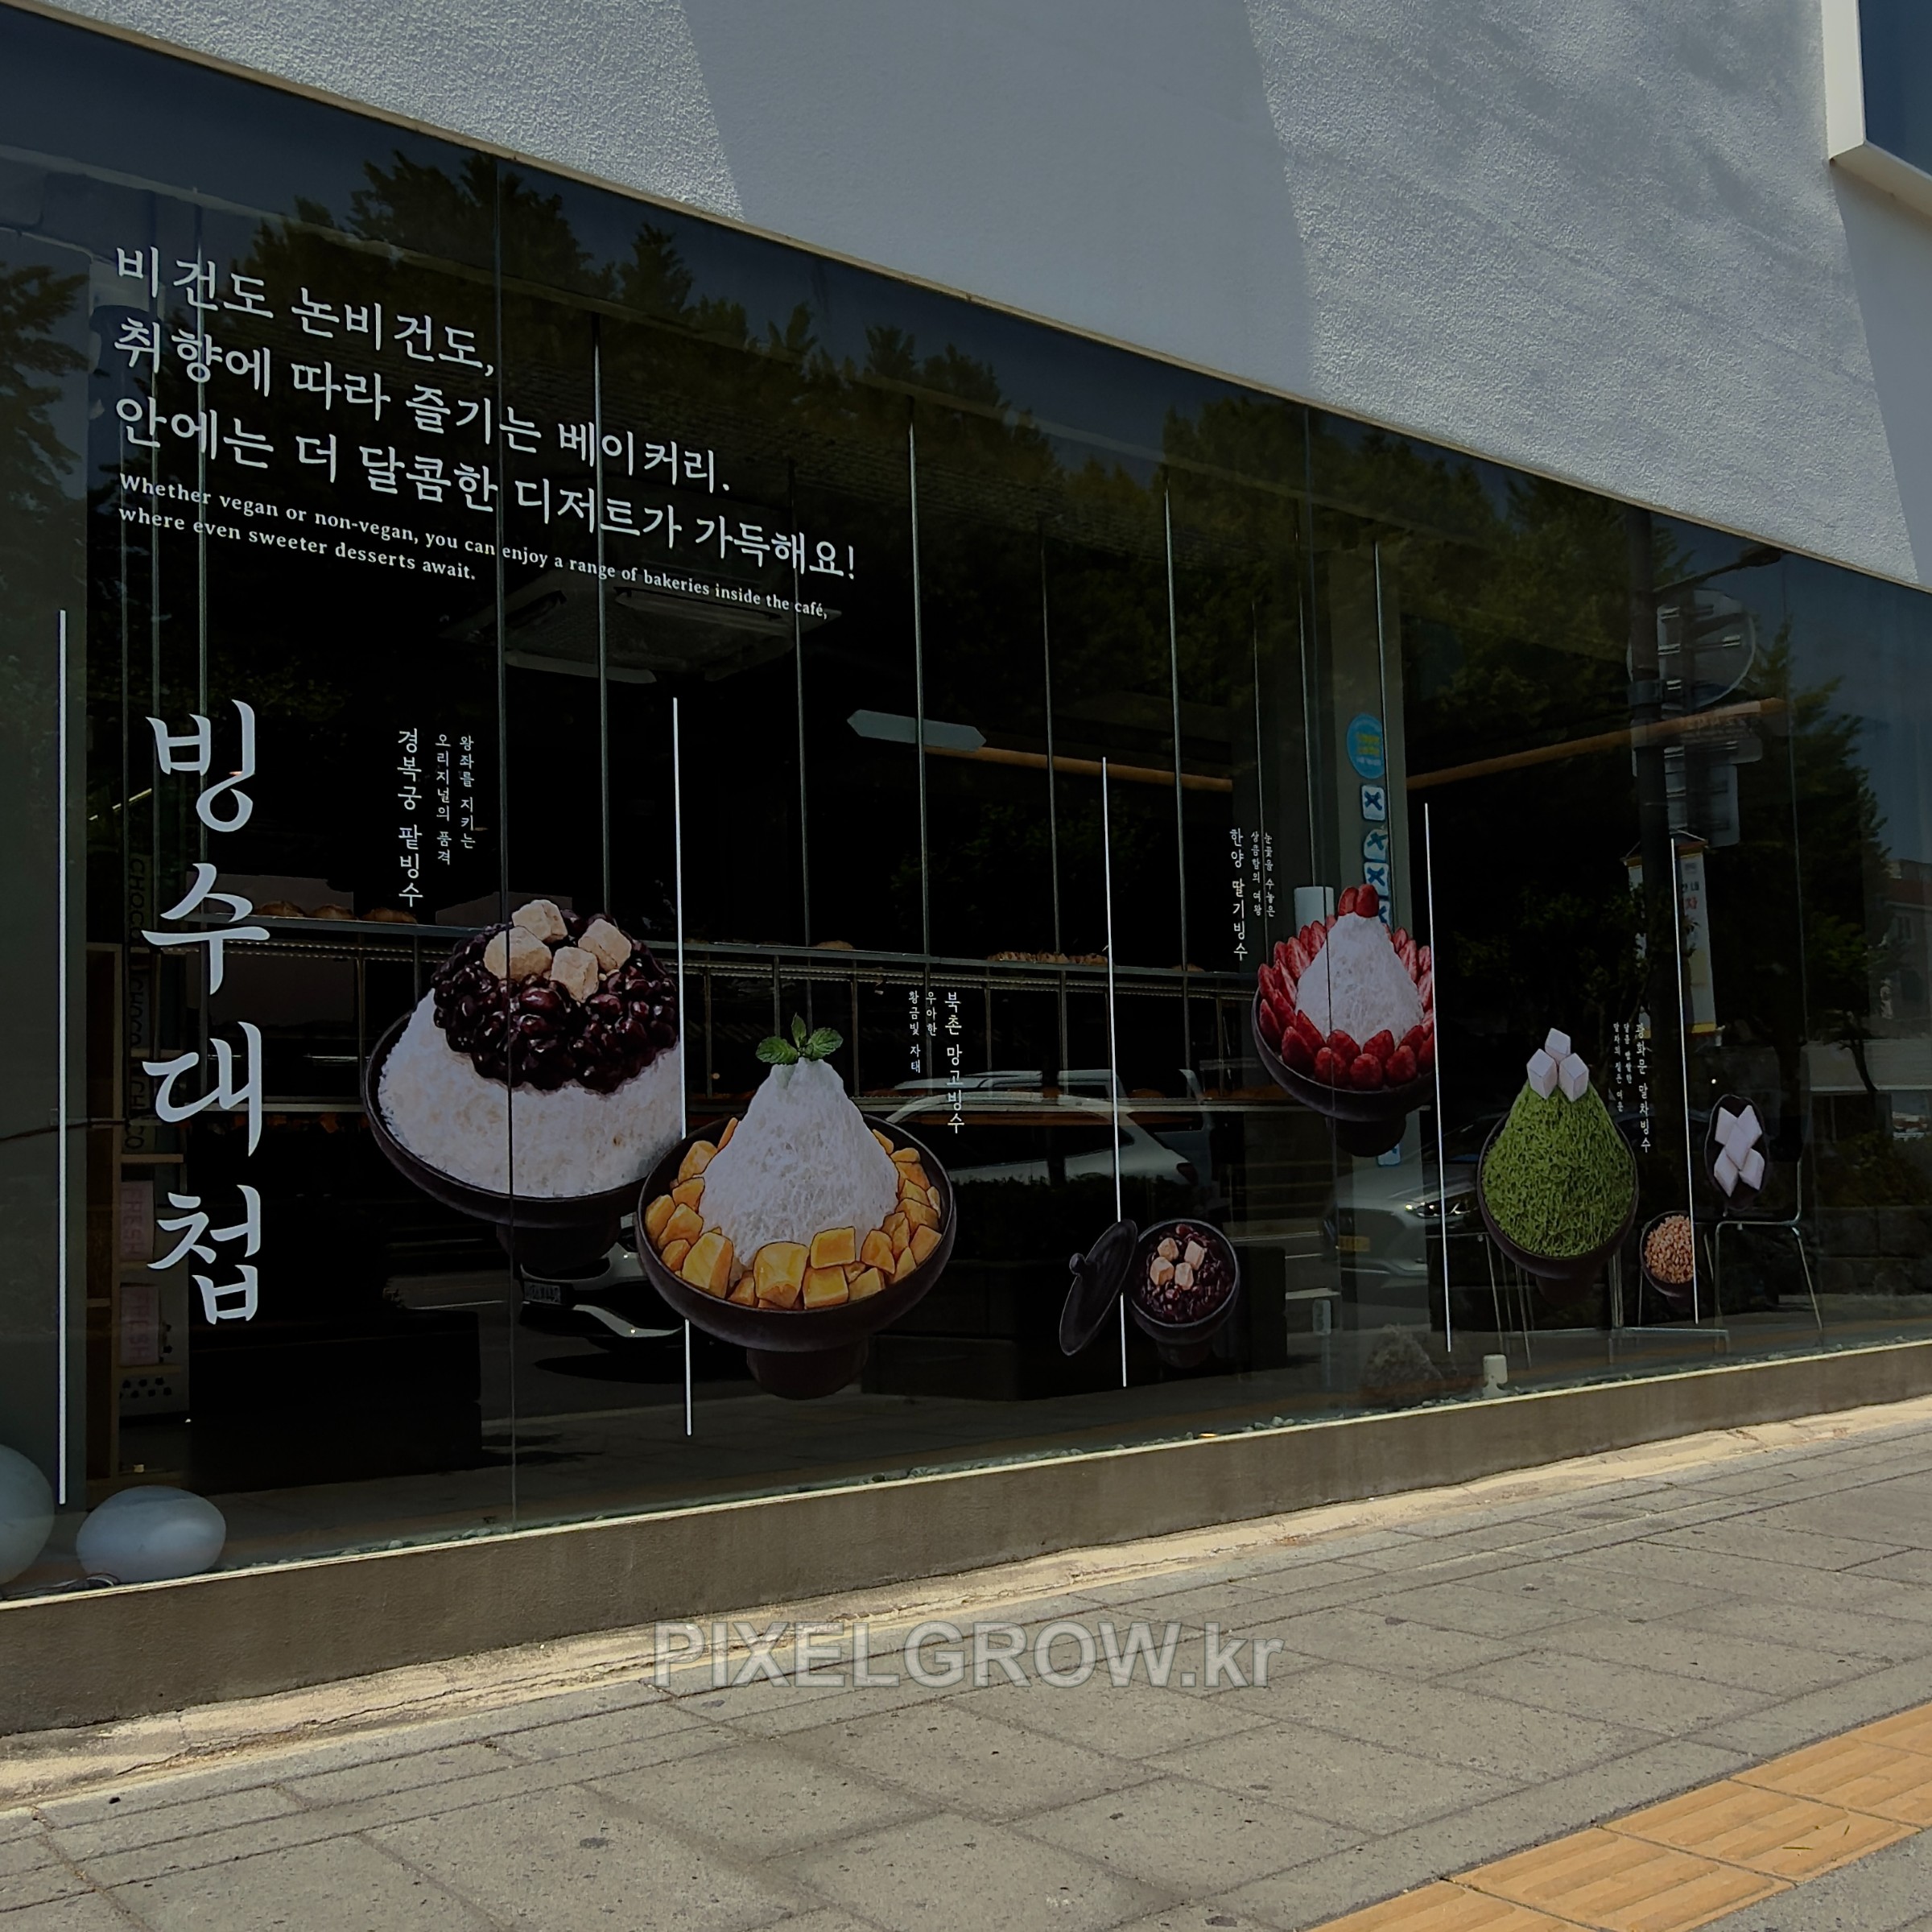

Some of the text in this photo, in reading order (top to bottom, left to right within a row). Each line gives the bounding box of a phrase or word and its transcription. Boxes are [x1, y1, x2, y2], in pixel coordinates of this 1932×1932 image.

[116, 246, 495, 377] 비건도 논비건도,
[114, 317, 731, 493] 취향에 따라 즐기는 베이커리.
[115, 396, 855, 580] 안에는 더 달콤한 디저트가 가득해요!
[119, 506, 476, 580] where even sweeter desserts await.
[120, 473, 828, 621] Whether vegan or non-vegan, you can enjoy a range of bakeries inside the café,
[397, 728, 423, 907] 경복궁 팥빙수
[435, 734, 452, 865] 오리지널의 품격
[460, 735, 476, 848] 왕좌를 지키는
[1230, 828, 1248, 961] 한양 딸기빙수
[1253, 890, 1262, 916] 여왕
[142, 699, 270, 1325] 빙수대첩
[909, 990, 921, 1073] 황금빛 자태
[926, 992, 937, 1036] 우아한
[944, 992, 964, 1133] 북촌 망고빙수
[1636, 1022, 1651, 1153] 광화문 말차빙수
